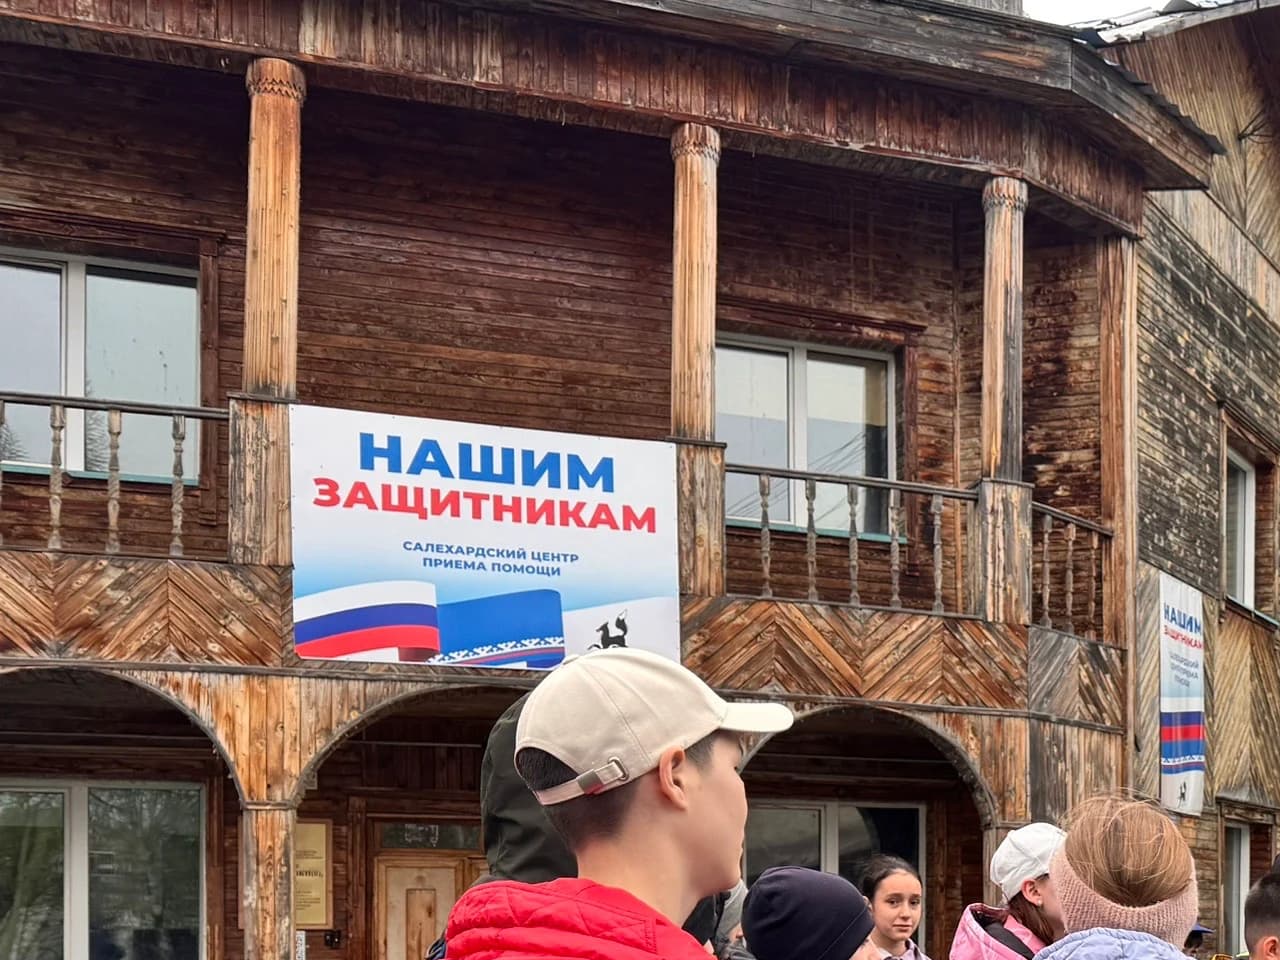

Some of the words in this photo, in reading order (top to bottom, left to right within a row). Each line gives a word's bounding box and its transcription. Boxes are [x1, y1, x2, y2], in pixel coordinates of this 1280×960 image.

[359, 432, 614, 493] НАШИМ
[312, 477, 656, 533] ЗАЩИТНИКАМ
[403, 540, 526, 560] САЛЕХАРДСКИЙ
[531, 550, 579, 563] ЦЕНТР
[423, 557, 486, 571] ПРИЕМА
[492, 562, 561, 577] ПОМОЩИ
[1164, 602, 1202, 636] НАШИМ
